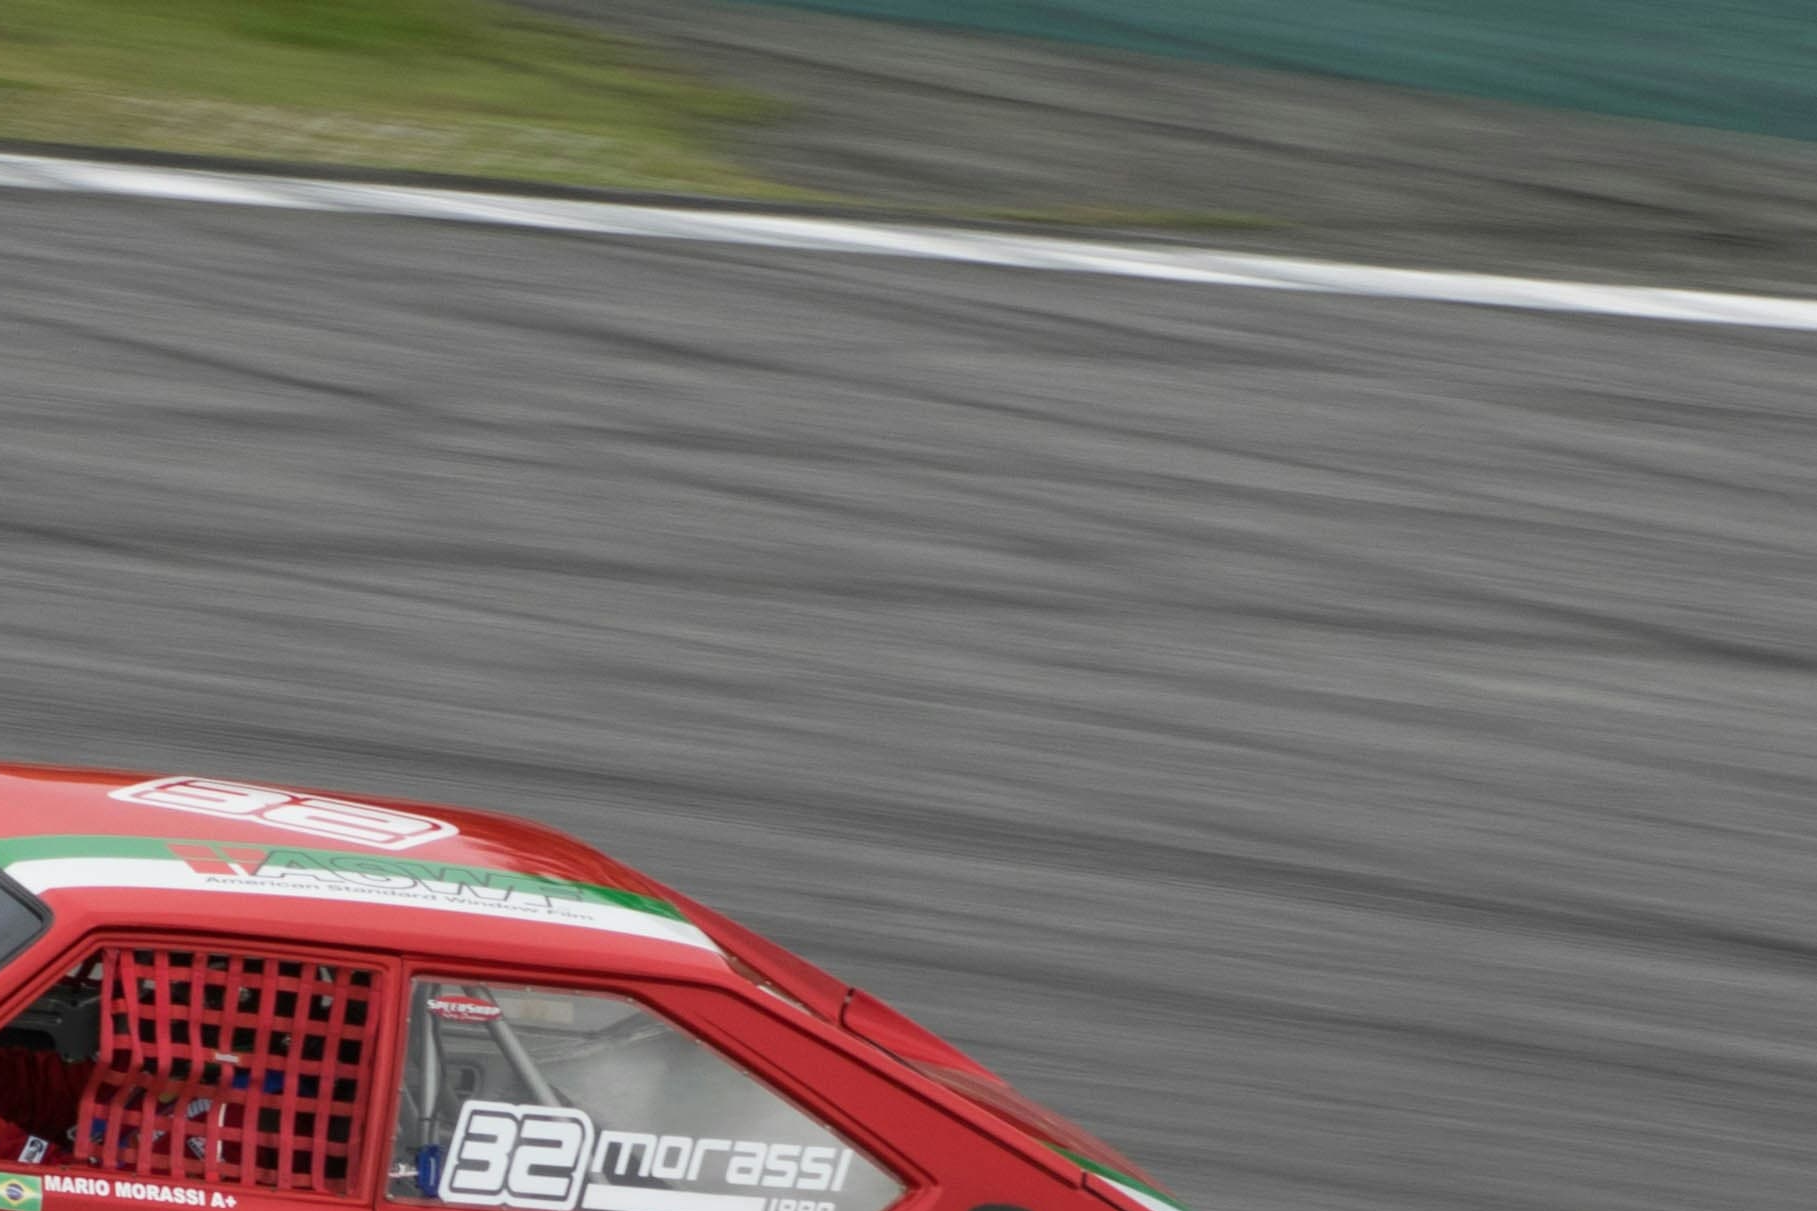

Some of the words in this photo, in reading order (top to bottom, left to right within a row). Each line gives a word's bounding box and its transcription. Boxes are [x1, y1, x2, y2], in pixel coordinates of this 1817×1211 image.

[122, 778, 450, 847] 32
[205, 876, 321, 891] American
[326, 884, 439, 902] Standard
[443, 895, 539, 915] Window
[546, 908, 596, 922] Film
[251, 850, 584, 909] ASWF
[442, 1107, 590, 1207] 32
[44, 1175, 110, 1198] MARIO
[115, 1182, 206, 1206] MORASSI
[211, 1193, 237, 1209] A+
